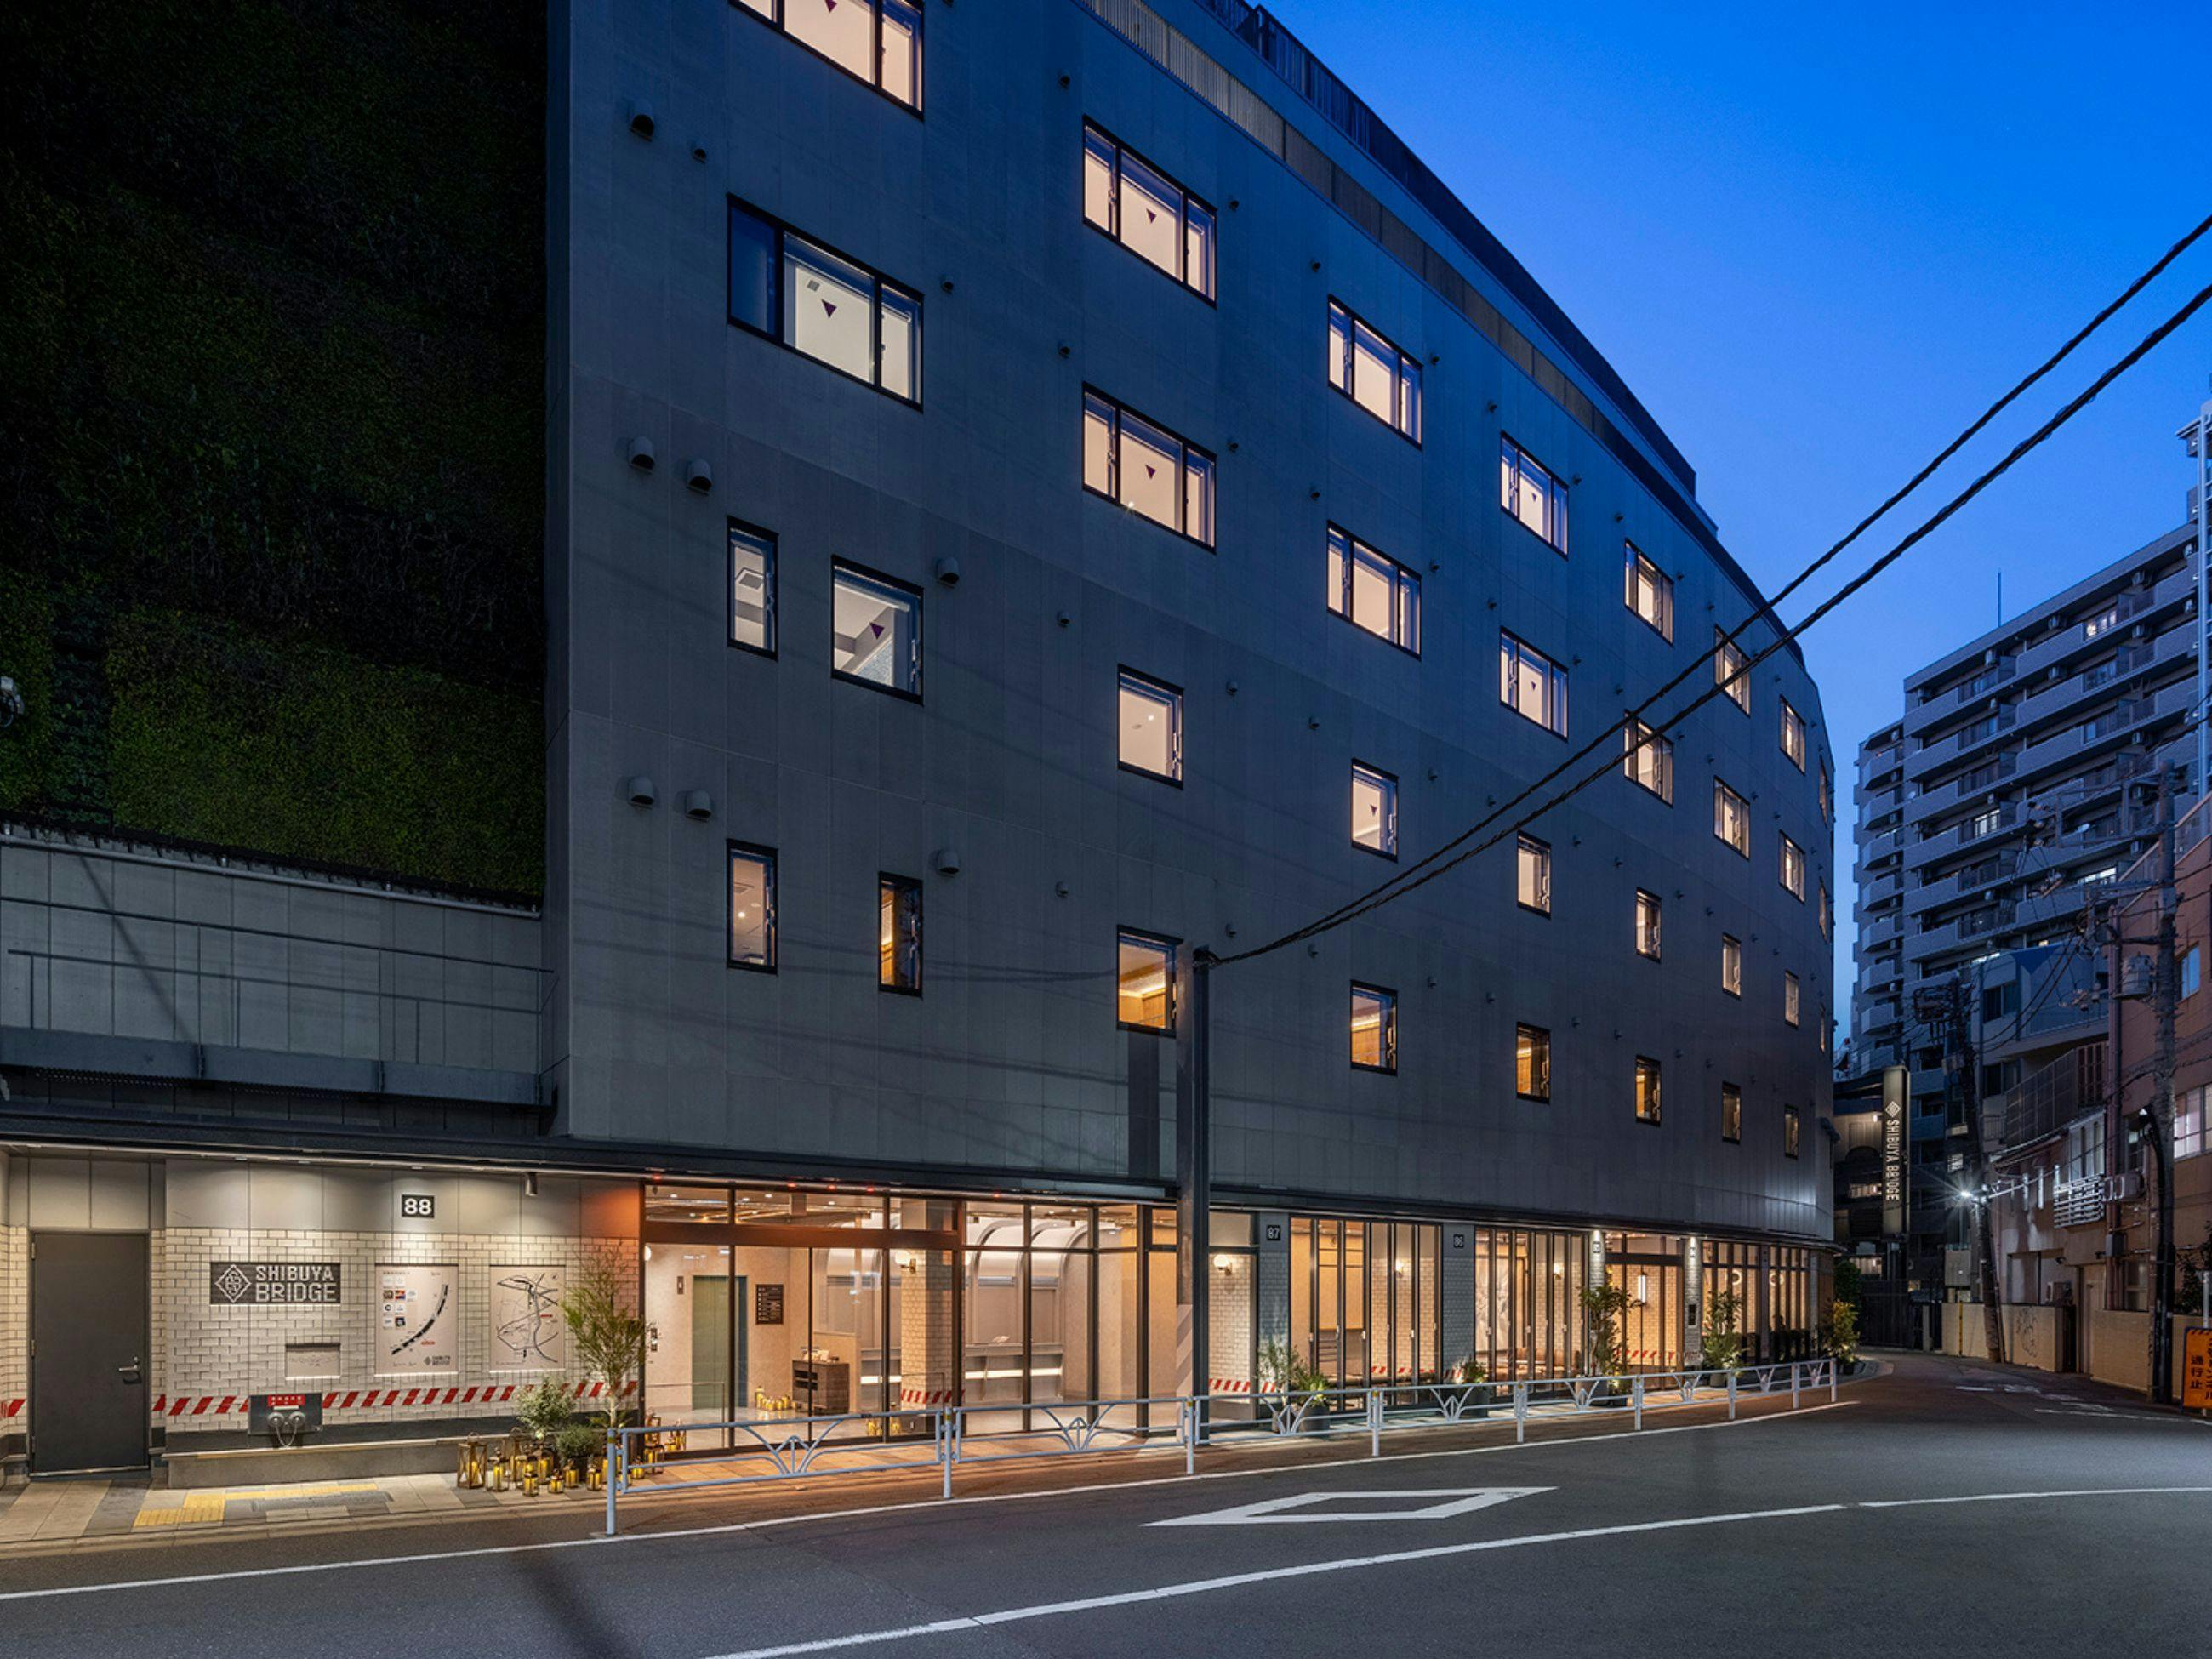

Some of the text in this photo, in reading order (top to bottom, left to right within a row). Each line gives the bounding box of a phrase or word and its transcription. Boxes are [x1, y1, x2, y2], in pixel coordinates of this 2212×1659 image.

[1885, 1119, 1900, 1201] SHIBUYA BRIDGE
[403, 1198, 433, 1215] 88
[1266, 1227, 1280, 1239] 87
[256, 1265, 334, 1281] SHIBUYA
[256, 1282, 337, 1303] BRIDGE
[2191, 1354, 2203, 1389] 通行止
